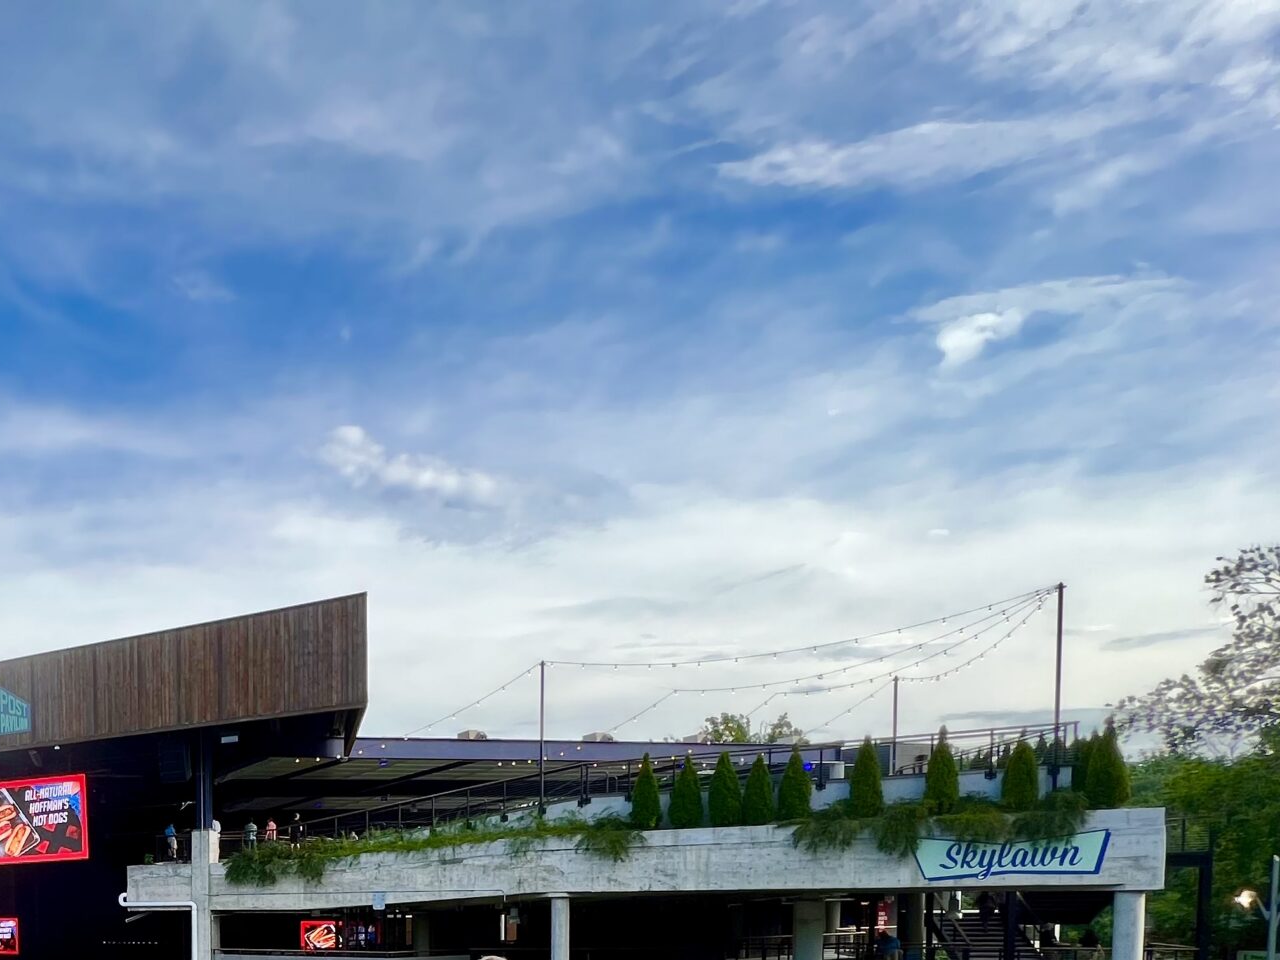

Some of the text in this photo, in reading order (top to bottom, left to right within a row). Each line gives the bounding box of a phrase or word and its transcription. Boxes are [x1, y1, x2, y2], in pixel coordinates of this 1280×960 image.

[0, 689, 28, 717] POST
[29, 798, 69, 814] HOFFMAN'S
[32, 811, 68, 827] HOT DOGS
[938, 841, 1083, 880] Skylawn
